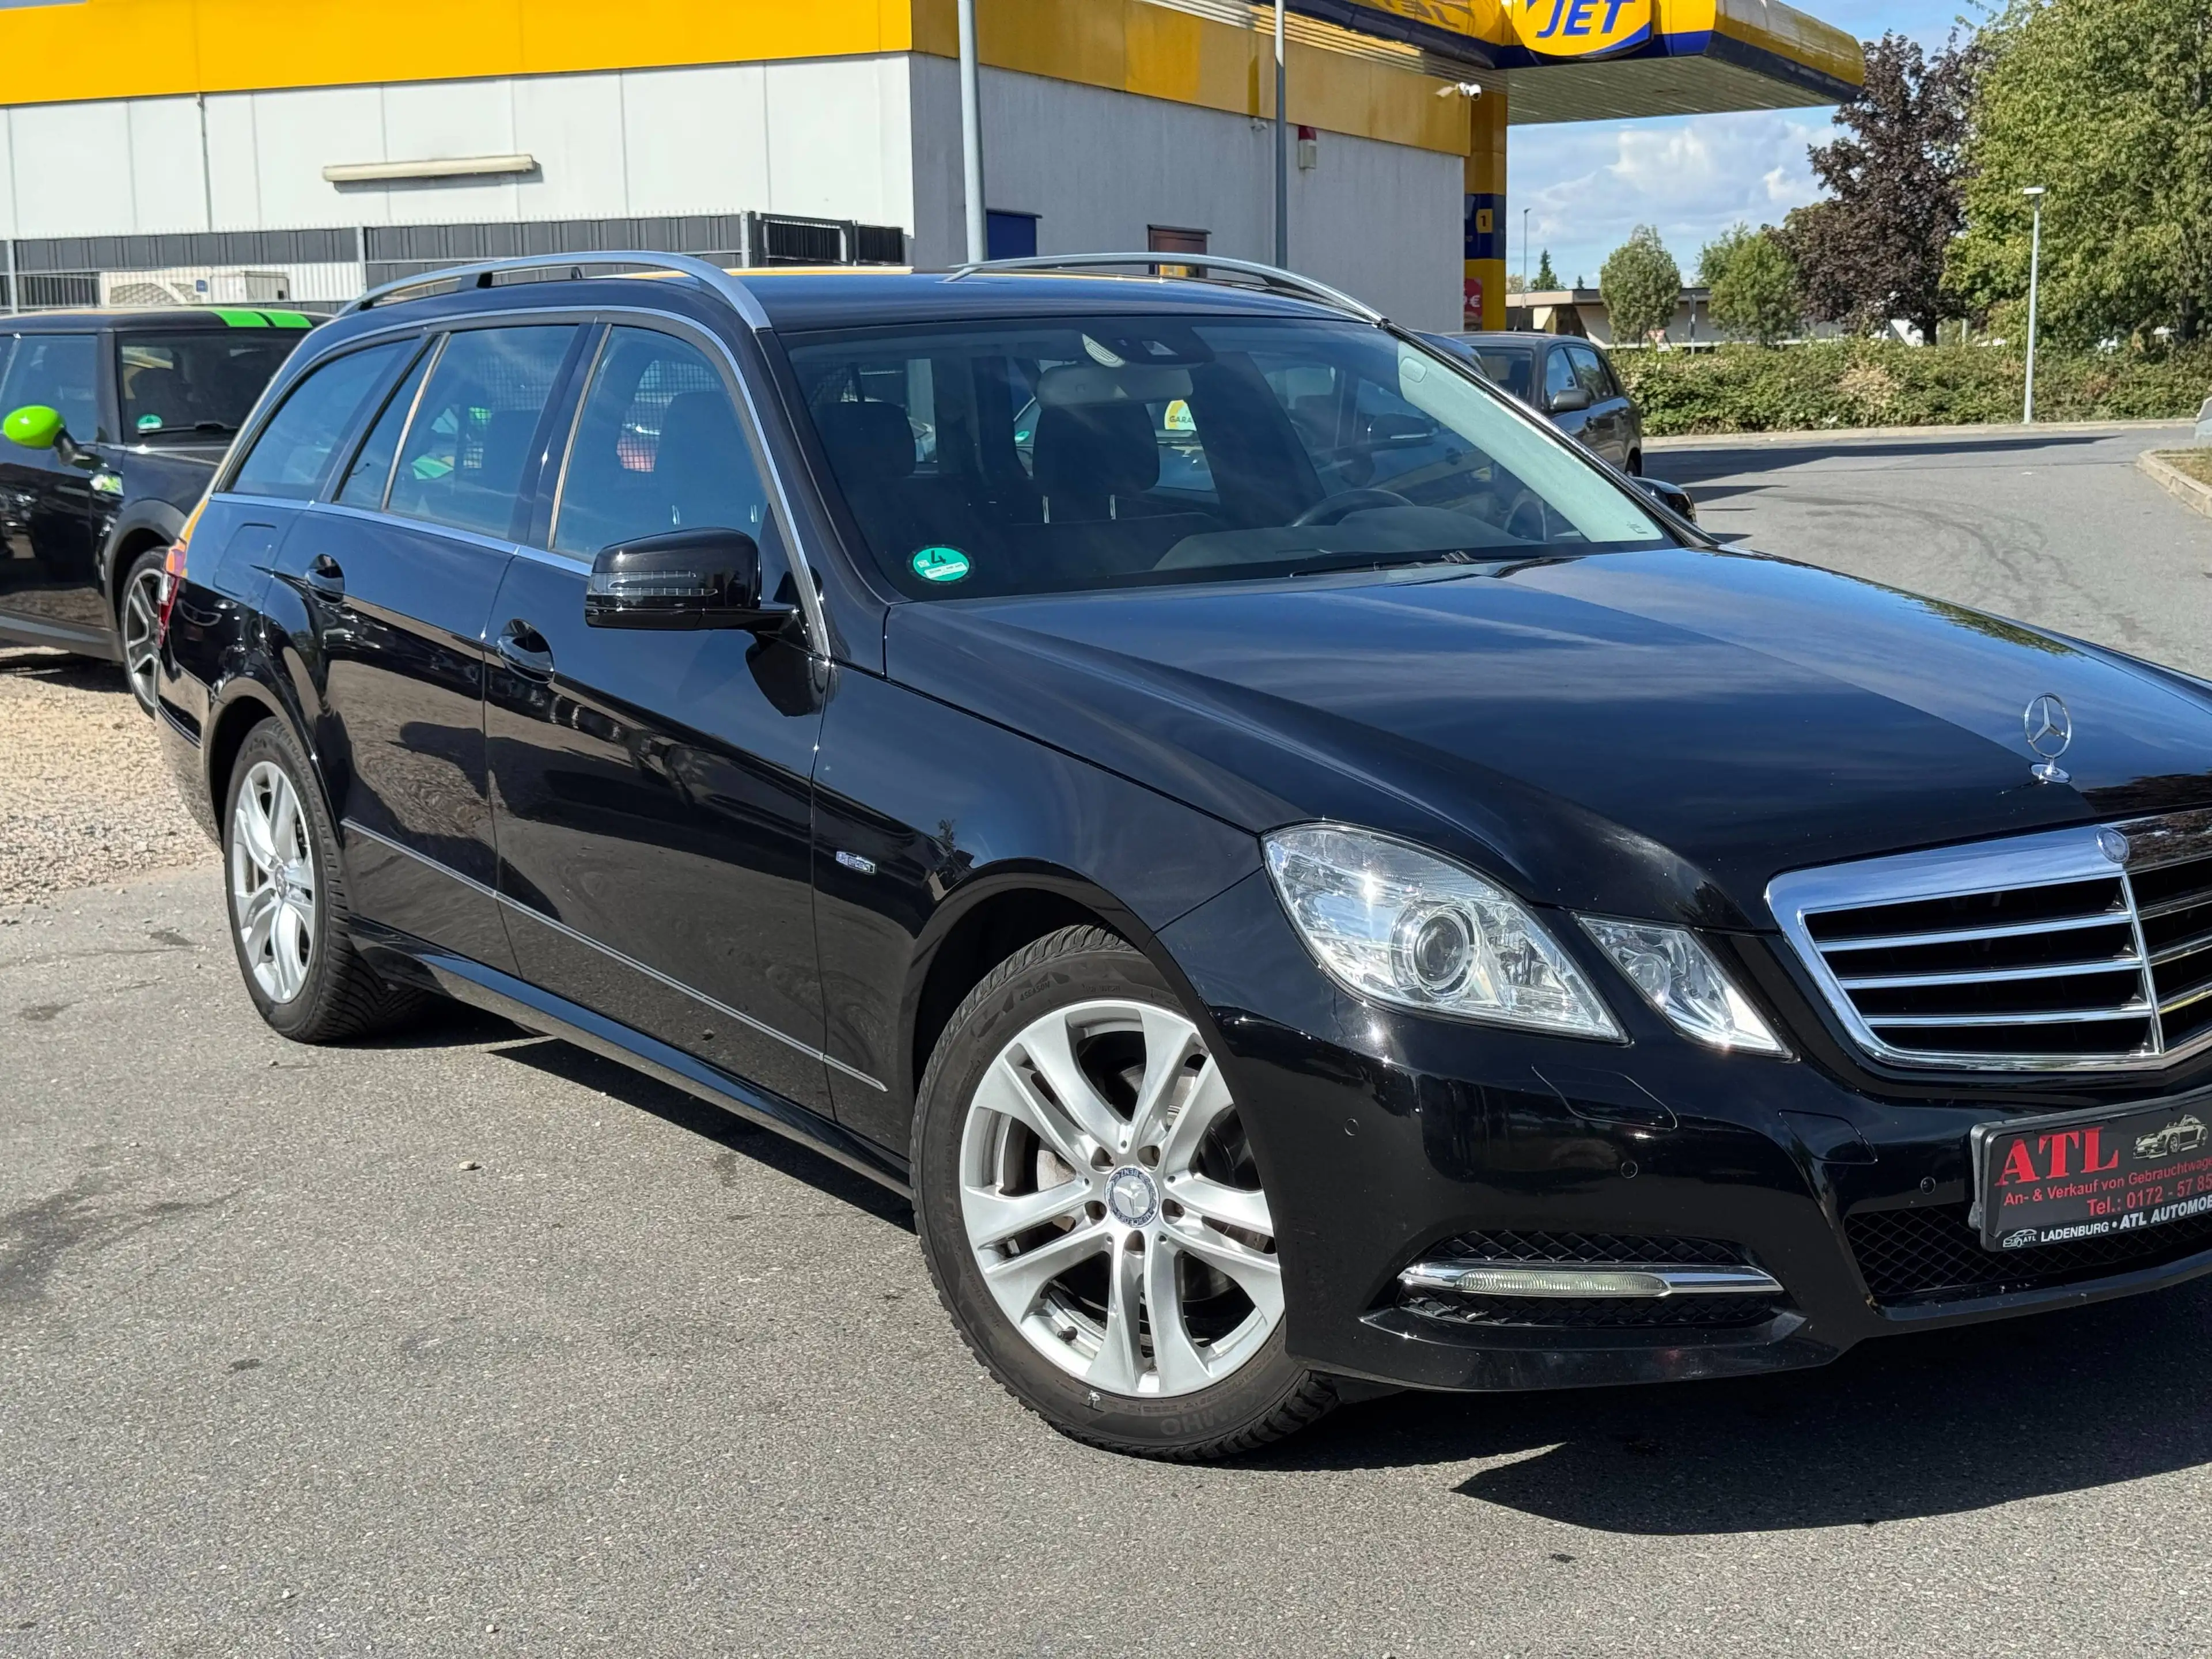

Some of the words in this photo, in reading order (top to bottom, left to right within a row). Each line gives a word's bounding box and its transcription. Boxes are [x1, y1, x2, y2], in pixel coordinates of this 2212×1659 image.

[1535, 0, 1635, 39] JET
[1480, 215, 1486, 227] 1
[930, 550, 946, 564] 4
[1994, 1126, 2119, 1187] ATL
[2003, 1191, 2029, 1206] An-
[2032, 1188, 2043, 1202] &
[2047, 1179, 2099, 1200] Verkauf
[2101, 1176, 2124, 1191] von
[2086, 1196, 2122, 1217] Tel.:
[2126, 1185, 2163, 1209] 0172
[2177, 1177, 2193, 1198] 57
[2196, 1171, 2212, 1192] 85
[2041, 1222, 2109, 1243] LADENBURG
[2119, 1211, 2147, 1230] ATL
